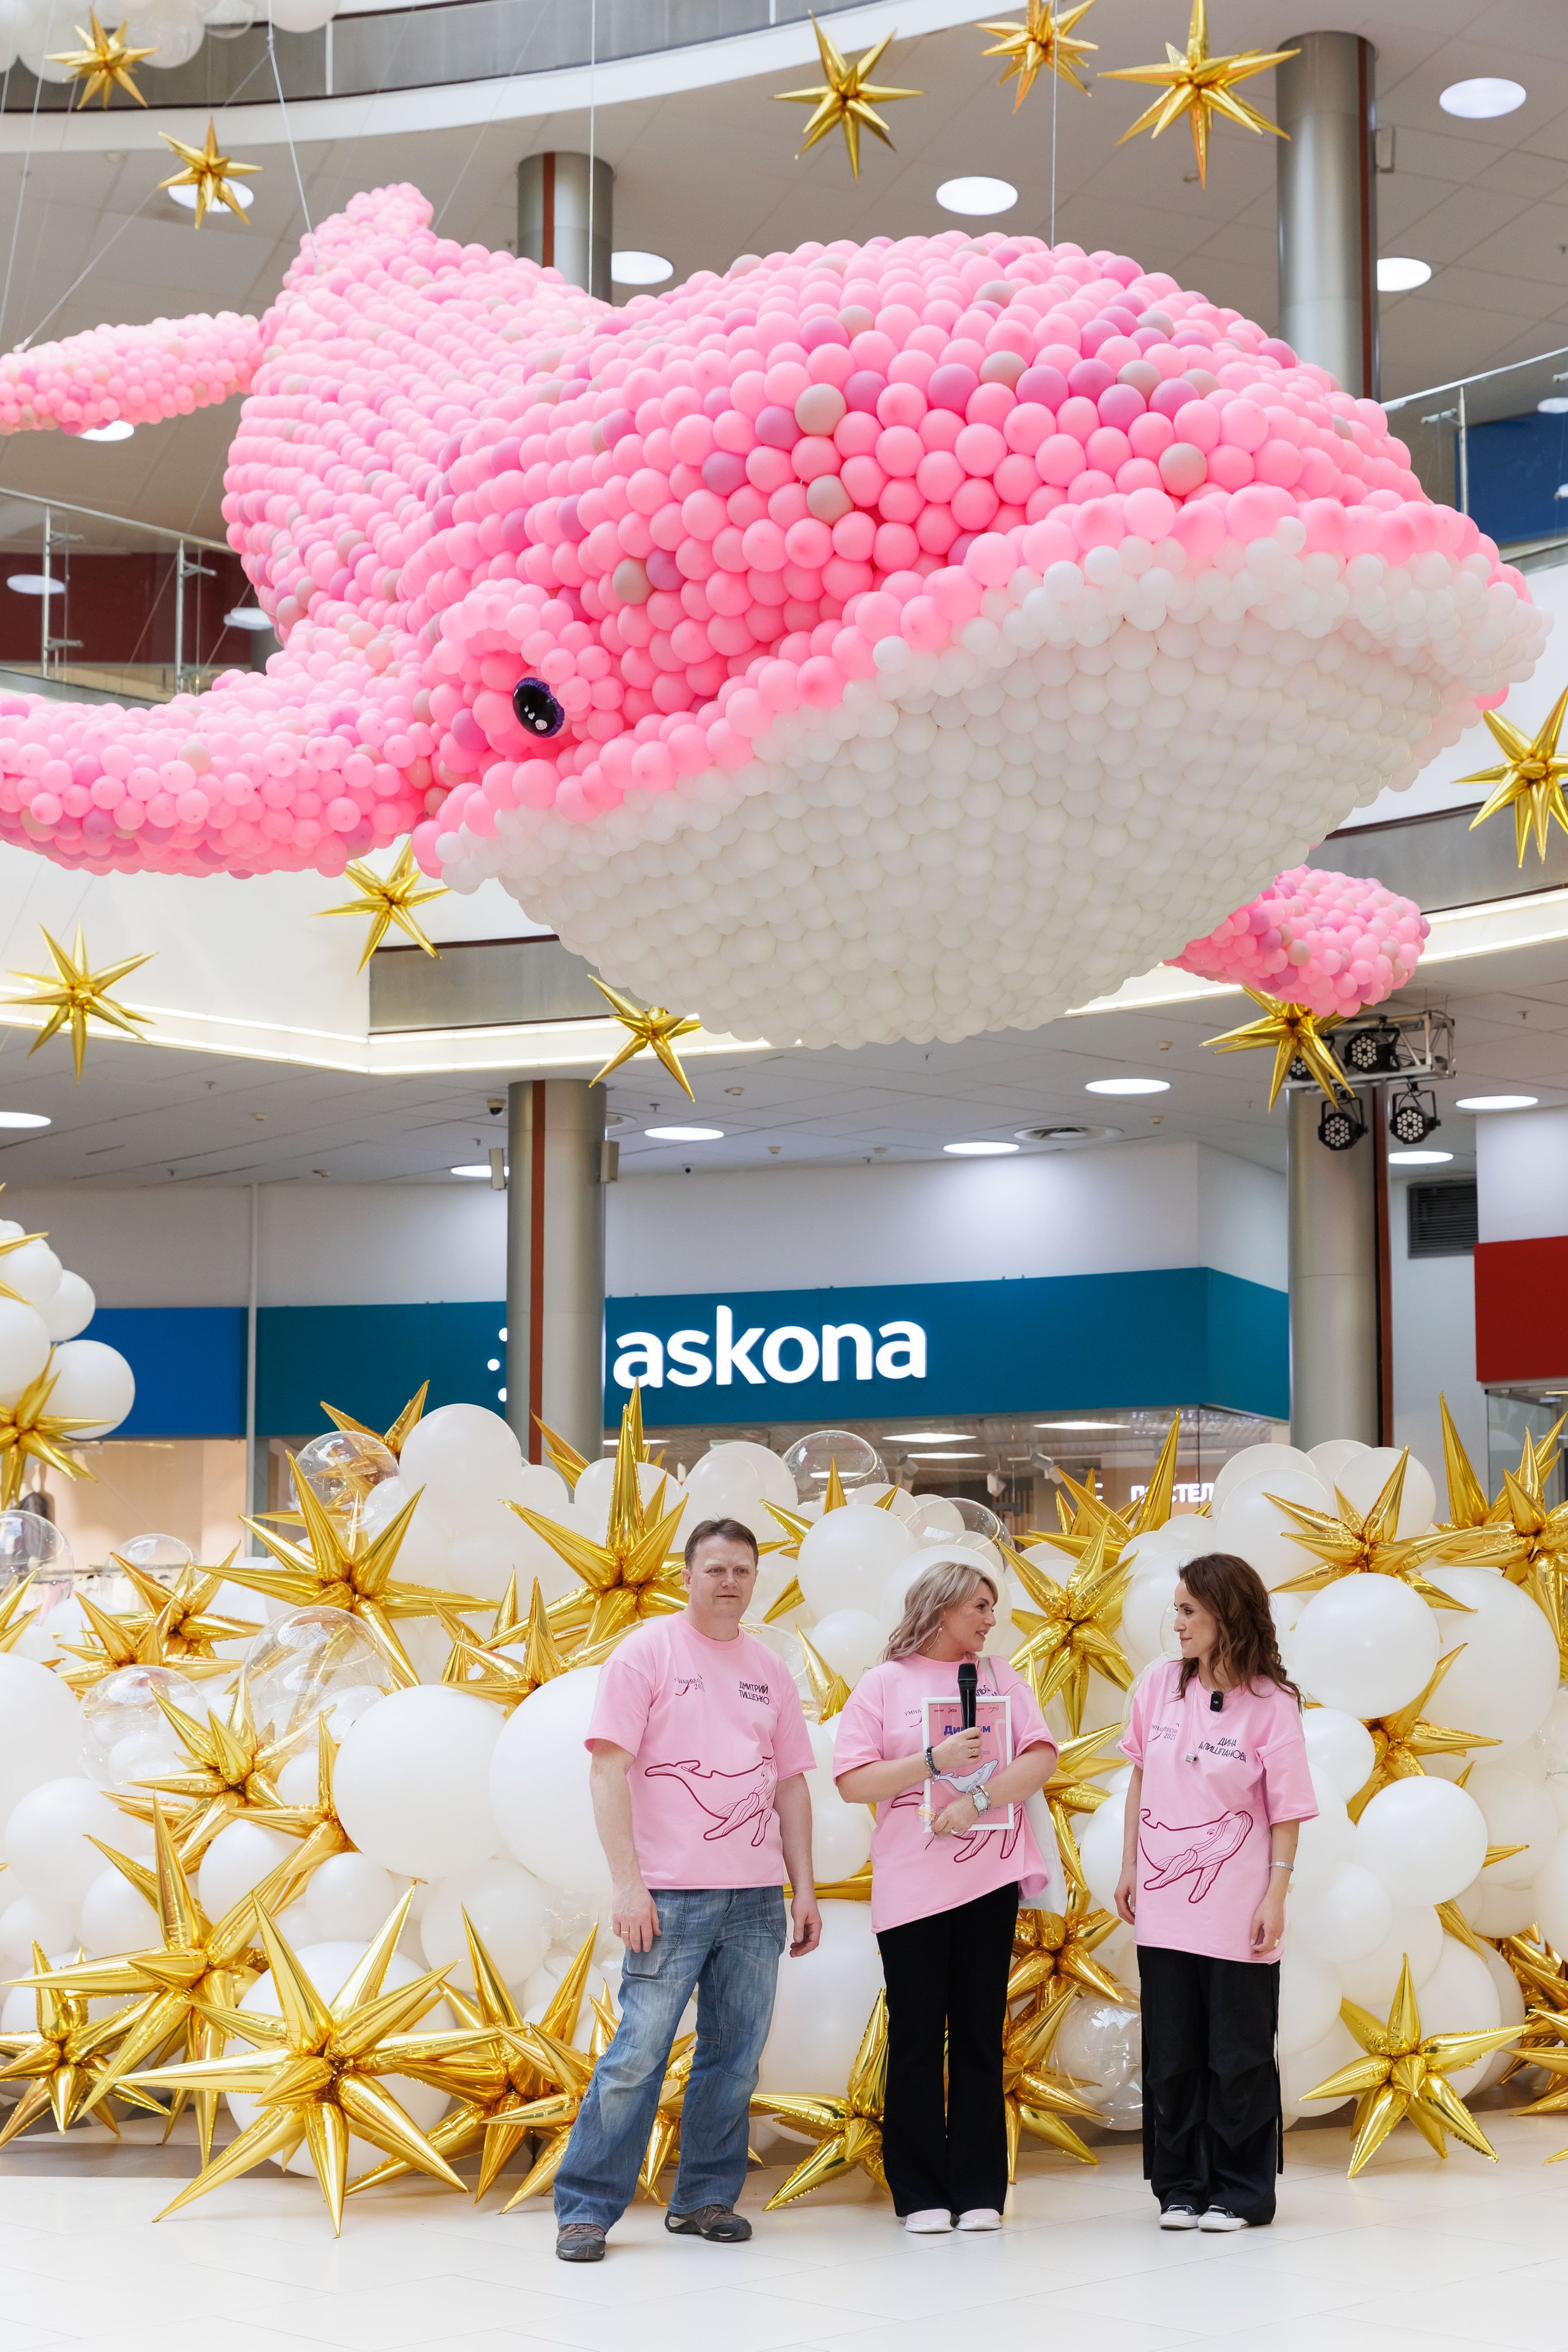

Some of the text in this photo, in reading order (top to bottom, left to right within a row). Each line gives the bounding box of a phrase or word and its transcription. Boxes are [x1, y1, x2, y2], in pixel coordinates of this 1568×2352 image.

[613, 1305, 927, 1389] askona
[1131, 1483, 1215, 1504] ПТЕЛ
[739, 1681, 768, 1694] ДМИТРИЙ
[738, 1689, 770, 1705] ТИЩЕНКО
[904, 1708, 922, 1717] УМНА
[1163, 1732, 1176, 1741] 2025
[1217, 1737, 1237, 1747] ДИНА
